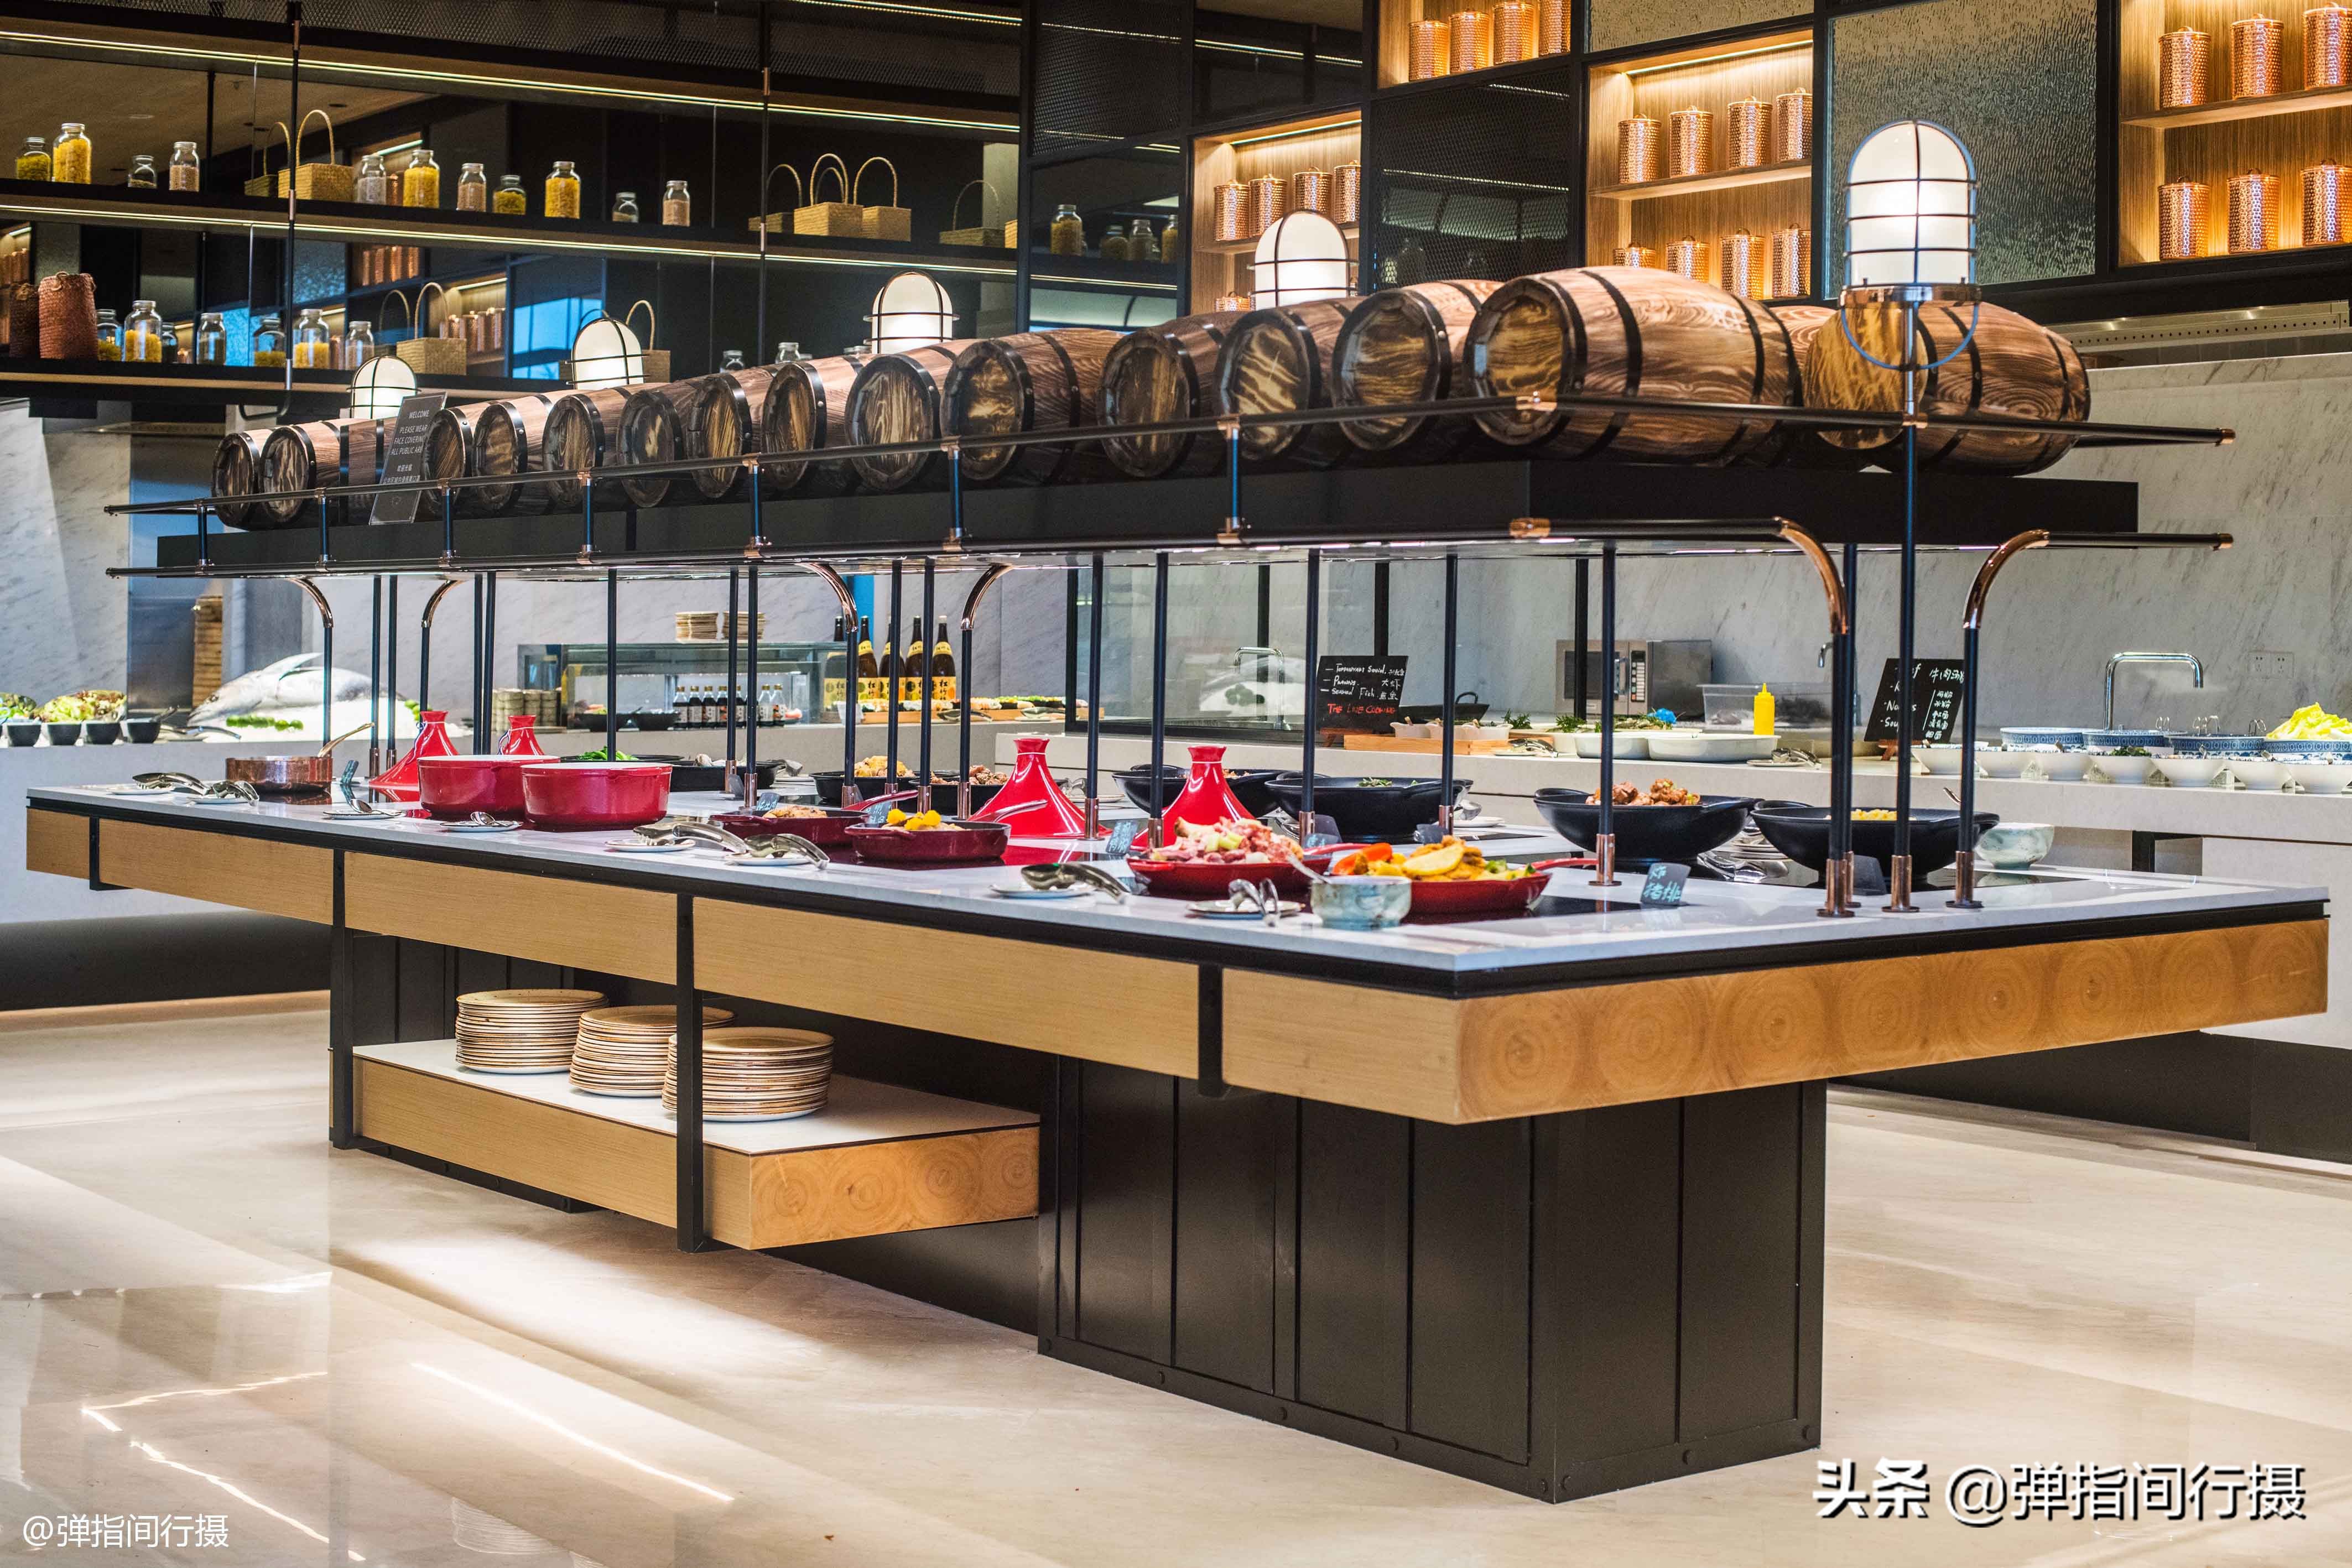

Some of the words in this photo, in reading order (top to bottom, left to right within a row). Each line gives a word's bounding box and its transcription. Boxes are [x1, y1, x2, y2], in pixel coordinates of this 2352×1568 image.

[409, 410, 430, 419] WELCOME
[399, 425, 415, 434] PLEASE
[1885, 717, 1899, 733] Sou
